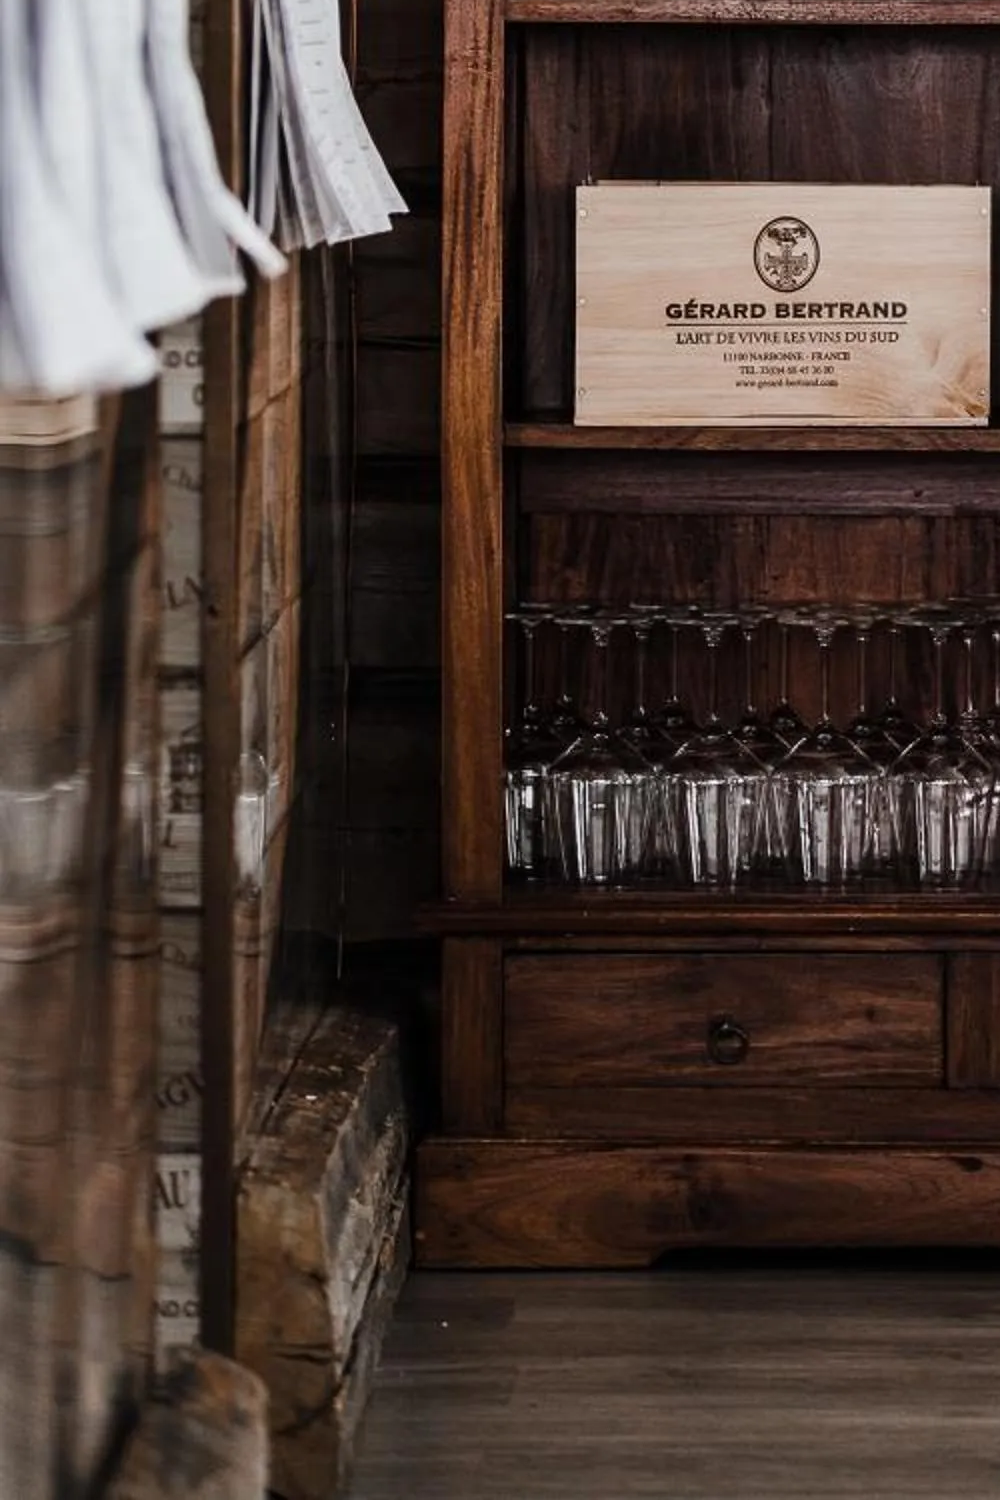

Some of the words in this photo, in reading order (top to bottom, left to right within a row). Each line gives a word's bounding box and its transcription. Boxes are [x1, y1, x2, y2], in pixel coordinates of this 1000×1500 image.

[665, 299, 766, 319] GÉRARD
[775, 302, 907, 319] BERTRAND
[717, 332, 735, 345] DE
[738, 332, 780, 345] VIVRE
[784, 332, 805, 344] LES
[808, 331, 841, 344] VINS
[845, 331, 867, 343] DU
[870, 331, 899, 343] SUD
[811, 351, 851, 361] FRANCE
